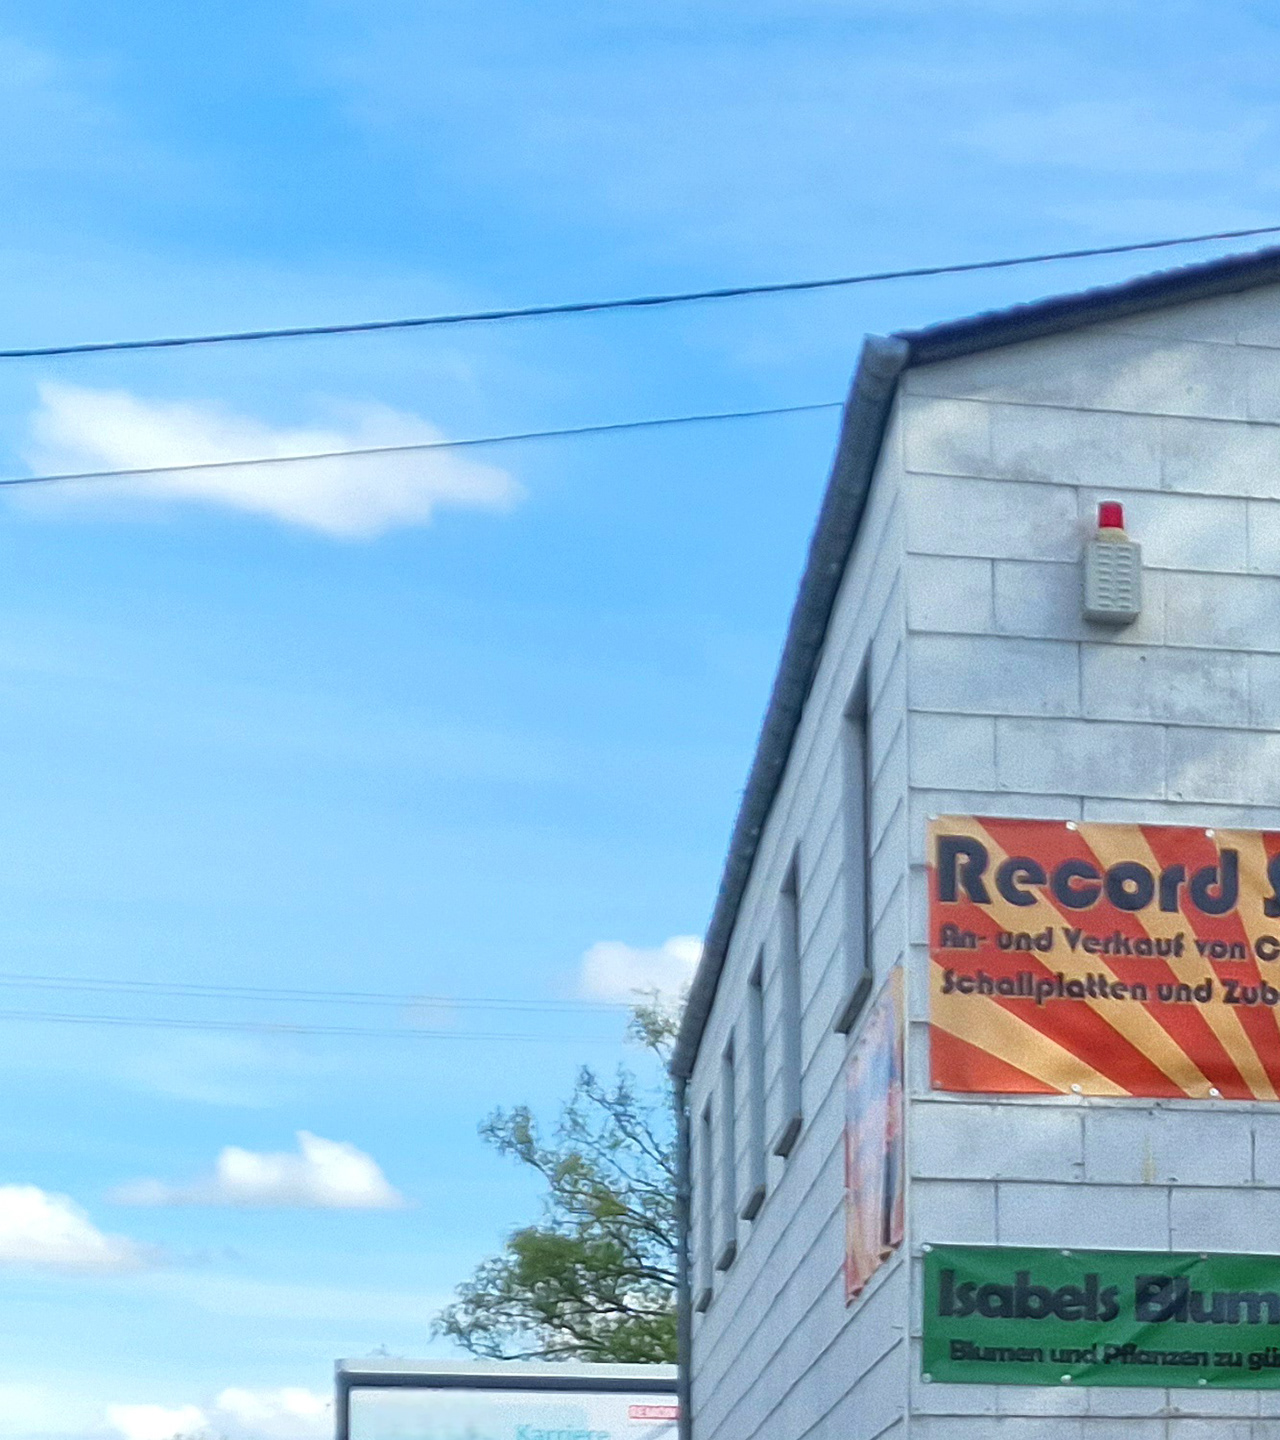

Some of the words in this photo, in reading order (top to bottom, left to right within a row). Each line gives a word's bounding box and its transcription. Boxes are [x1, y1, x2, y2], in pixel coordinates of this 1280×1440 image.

[935, 833, 1239, 916] Record
[939, 923, 988, 949] An-
[995, 926, 1053, 952] und
[1061, 927, 1185, 959] Verkauf
[1195, 938, 1246, 961] von
[940, 966, 1149, 1006] Schallplatten
[1157, 977, 1213, 1004] und
[938, 1268, 1120, 1323] Isabels
[949, 1338, 1043, 1363] Blumen
[1051, 1342, 1099, 1365] und
[1102, 1342, 1209, 1367] Pflanzen
[1213, 1352, 1243, 1368] zu
